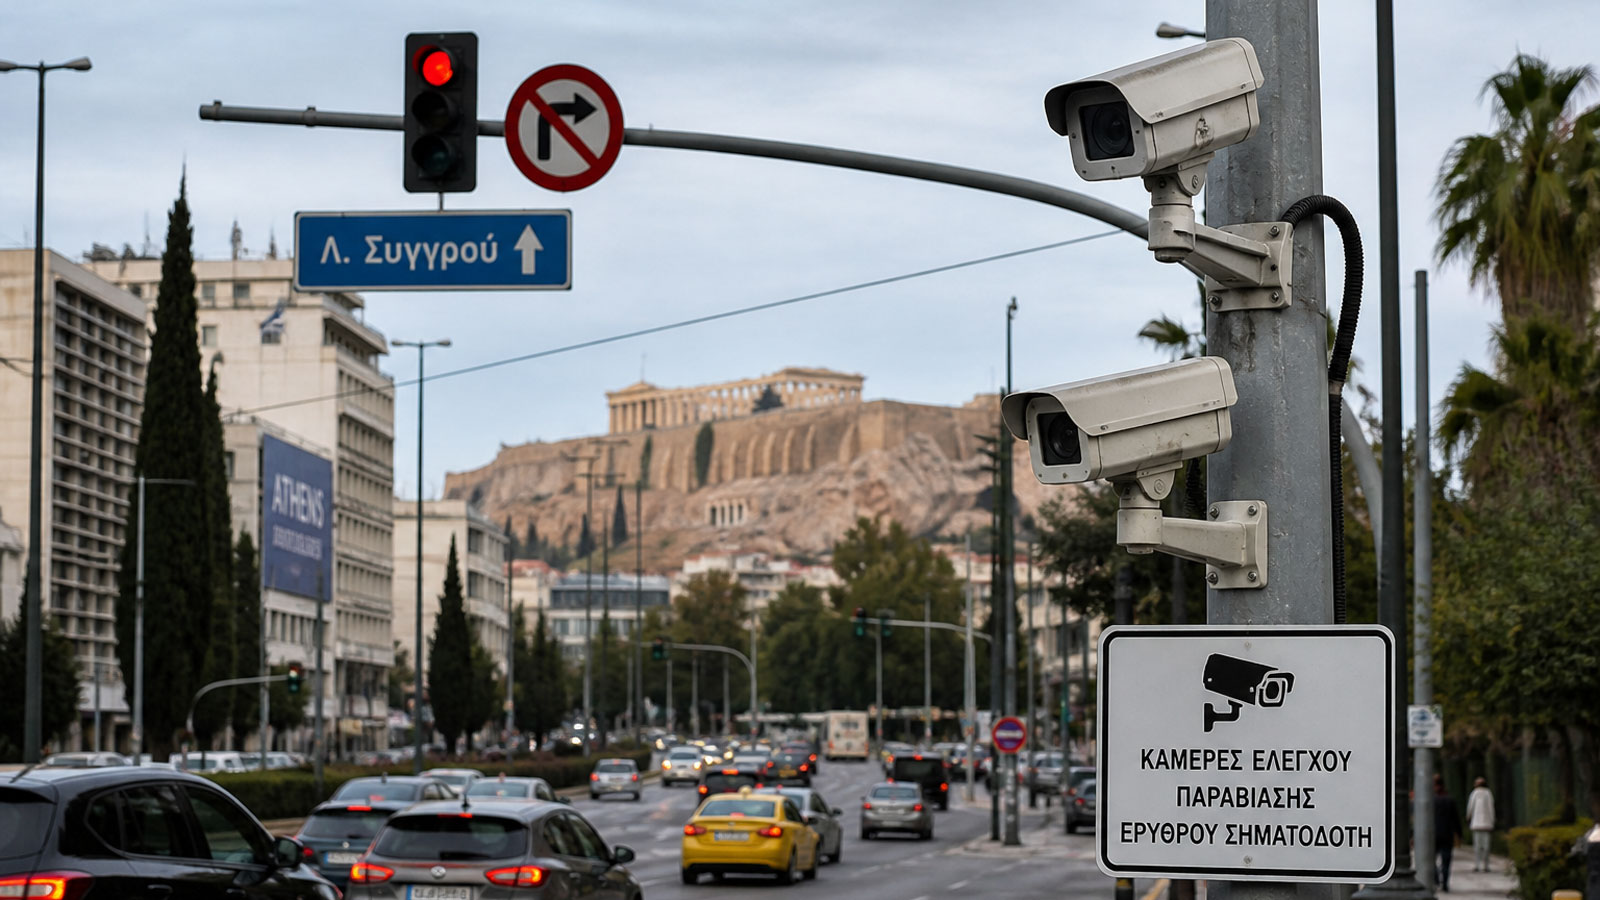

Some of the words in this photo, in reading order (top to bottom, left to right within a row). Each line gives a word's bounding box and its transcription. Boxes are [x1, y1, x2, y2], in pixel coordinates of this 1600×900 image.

[320, 236, 350, 264] Λ.
[364, 233, 498, 271] Συγγρού
[272, 473, 325, 529] ATHENS
[1141, 748, 1243, 771] ΚΑΜΕΡΕΣ
[1252, 749, 1352, 772] ΕΛΕΓΧΟΥ
[1176, 785, 1315, 809] ΠΑΡΑΒΙΑΣΗΣ
[1120, 821, 1219, 845] ΕΡΥΘΡΟΥ
[1225, 823, 1372, 848] ΣΗΜΑΤΟΔΟΤΗ
